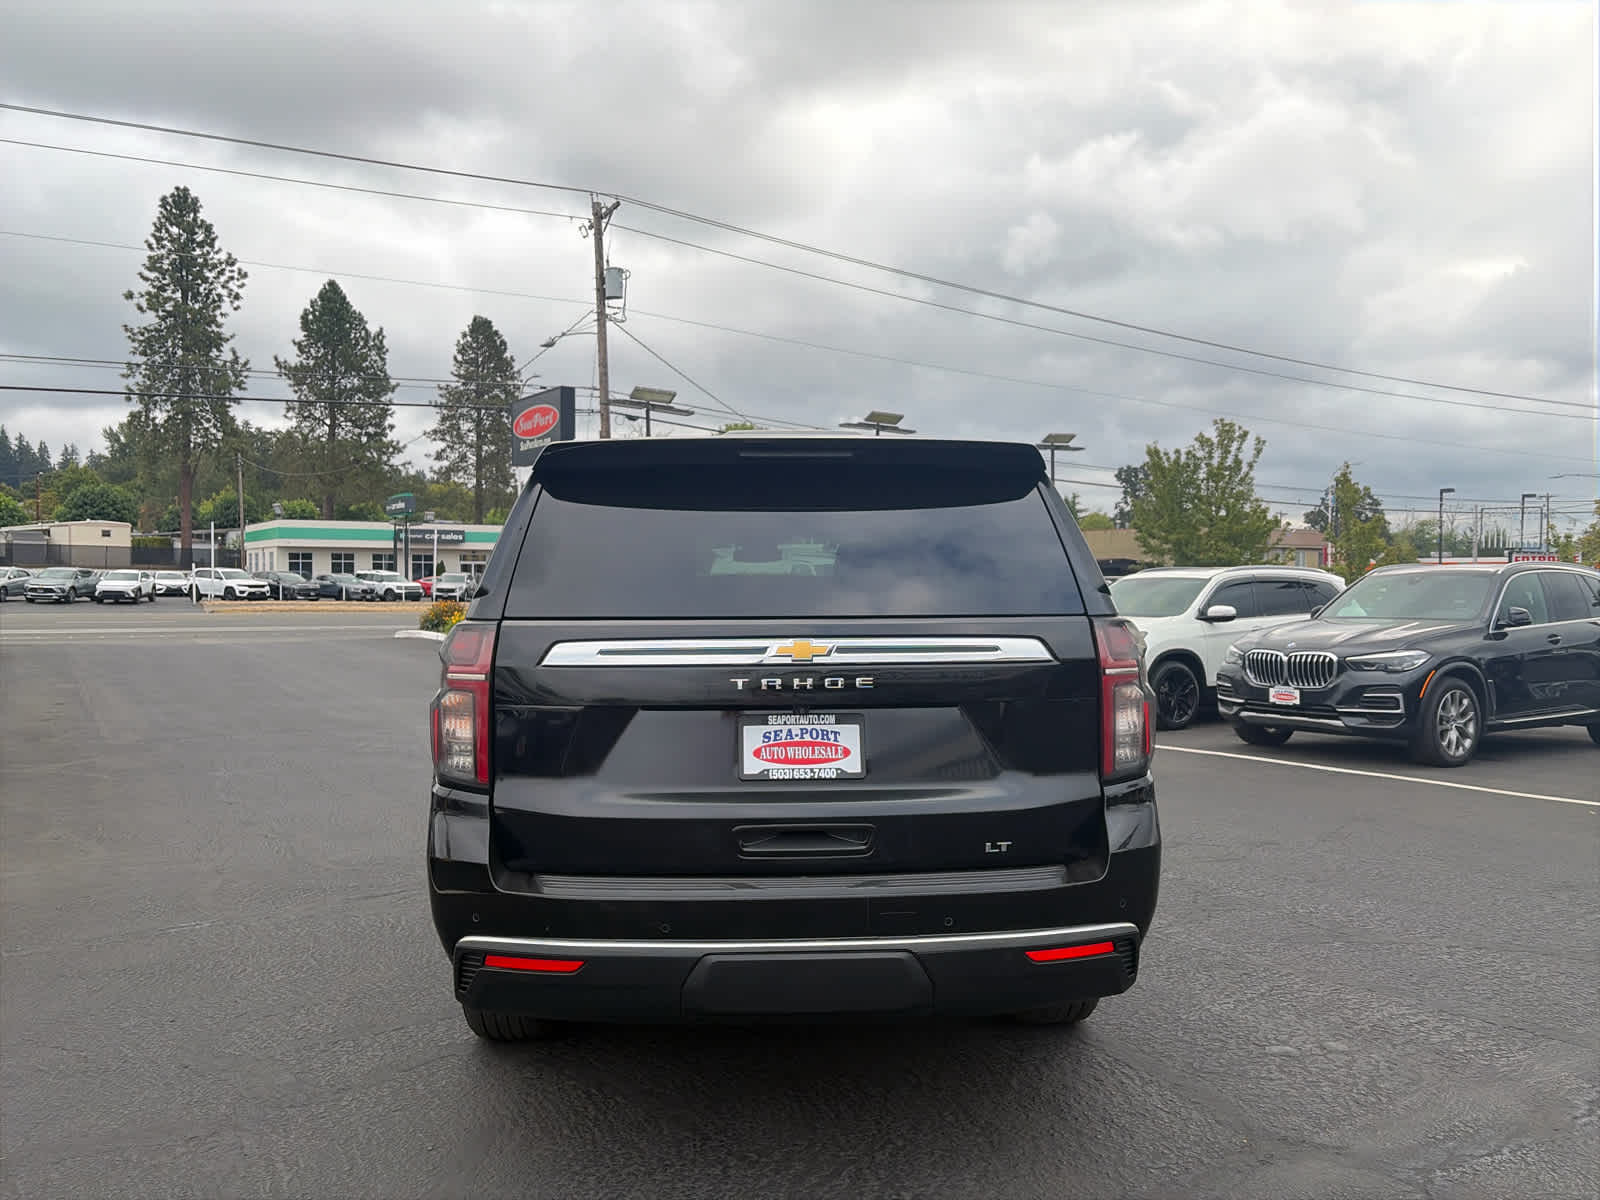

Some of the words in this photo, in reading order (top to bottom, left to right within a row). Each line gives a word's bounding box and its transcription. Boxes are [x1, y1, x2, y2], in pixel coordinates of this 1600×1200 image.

[441, 532, 463, 540] sales
[729, 677, 875, 690] TAHOE
[767, 714, 836, 725] SEAPORTAUTO.COM
[761, 727, 841, 744] SEA-PORT
[759, 747, 786, 760] AUTO
[787, 746, 844, 760] WHOLESALE
[985, 841, 1013, 852] LT
